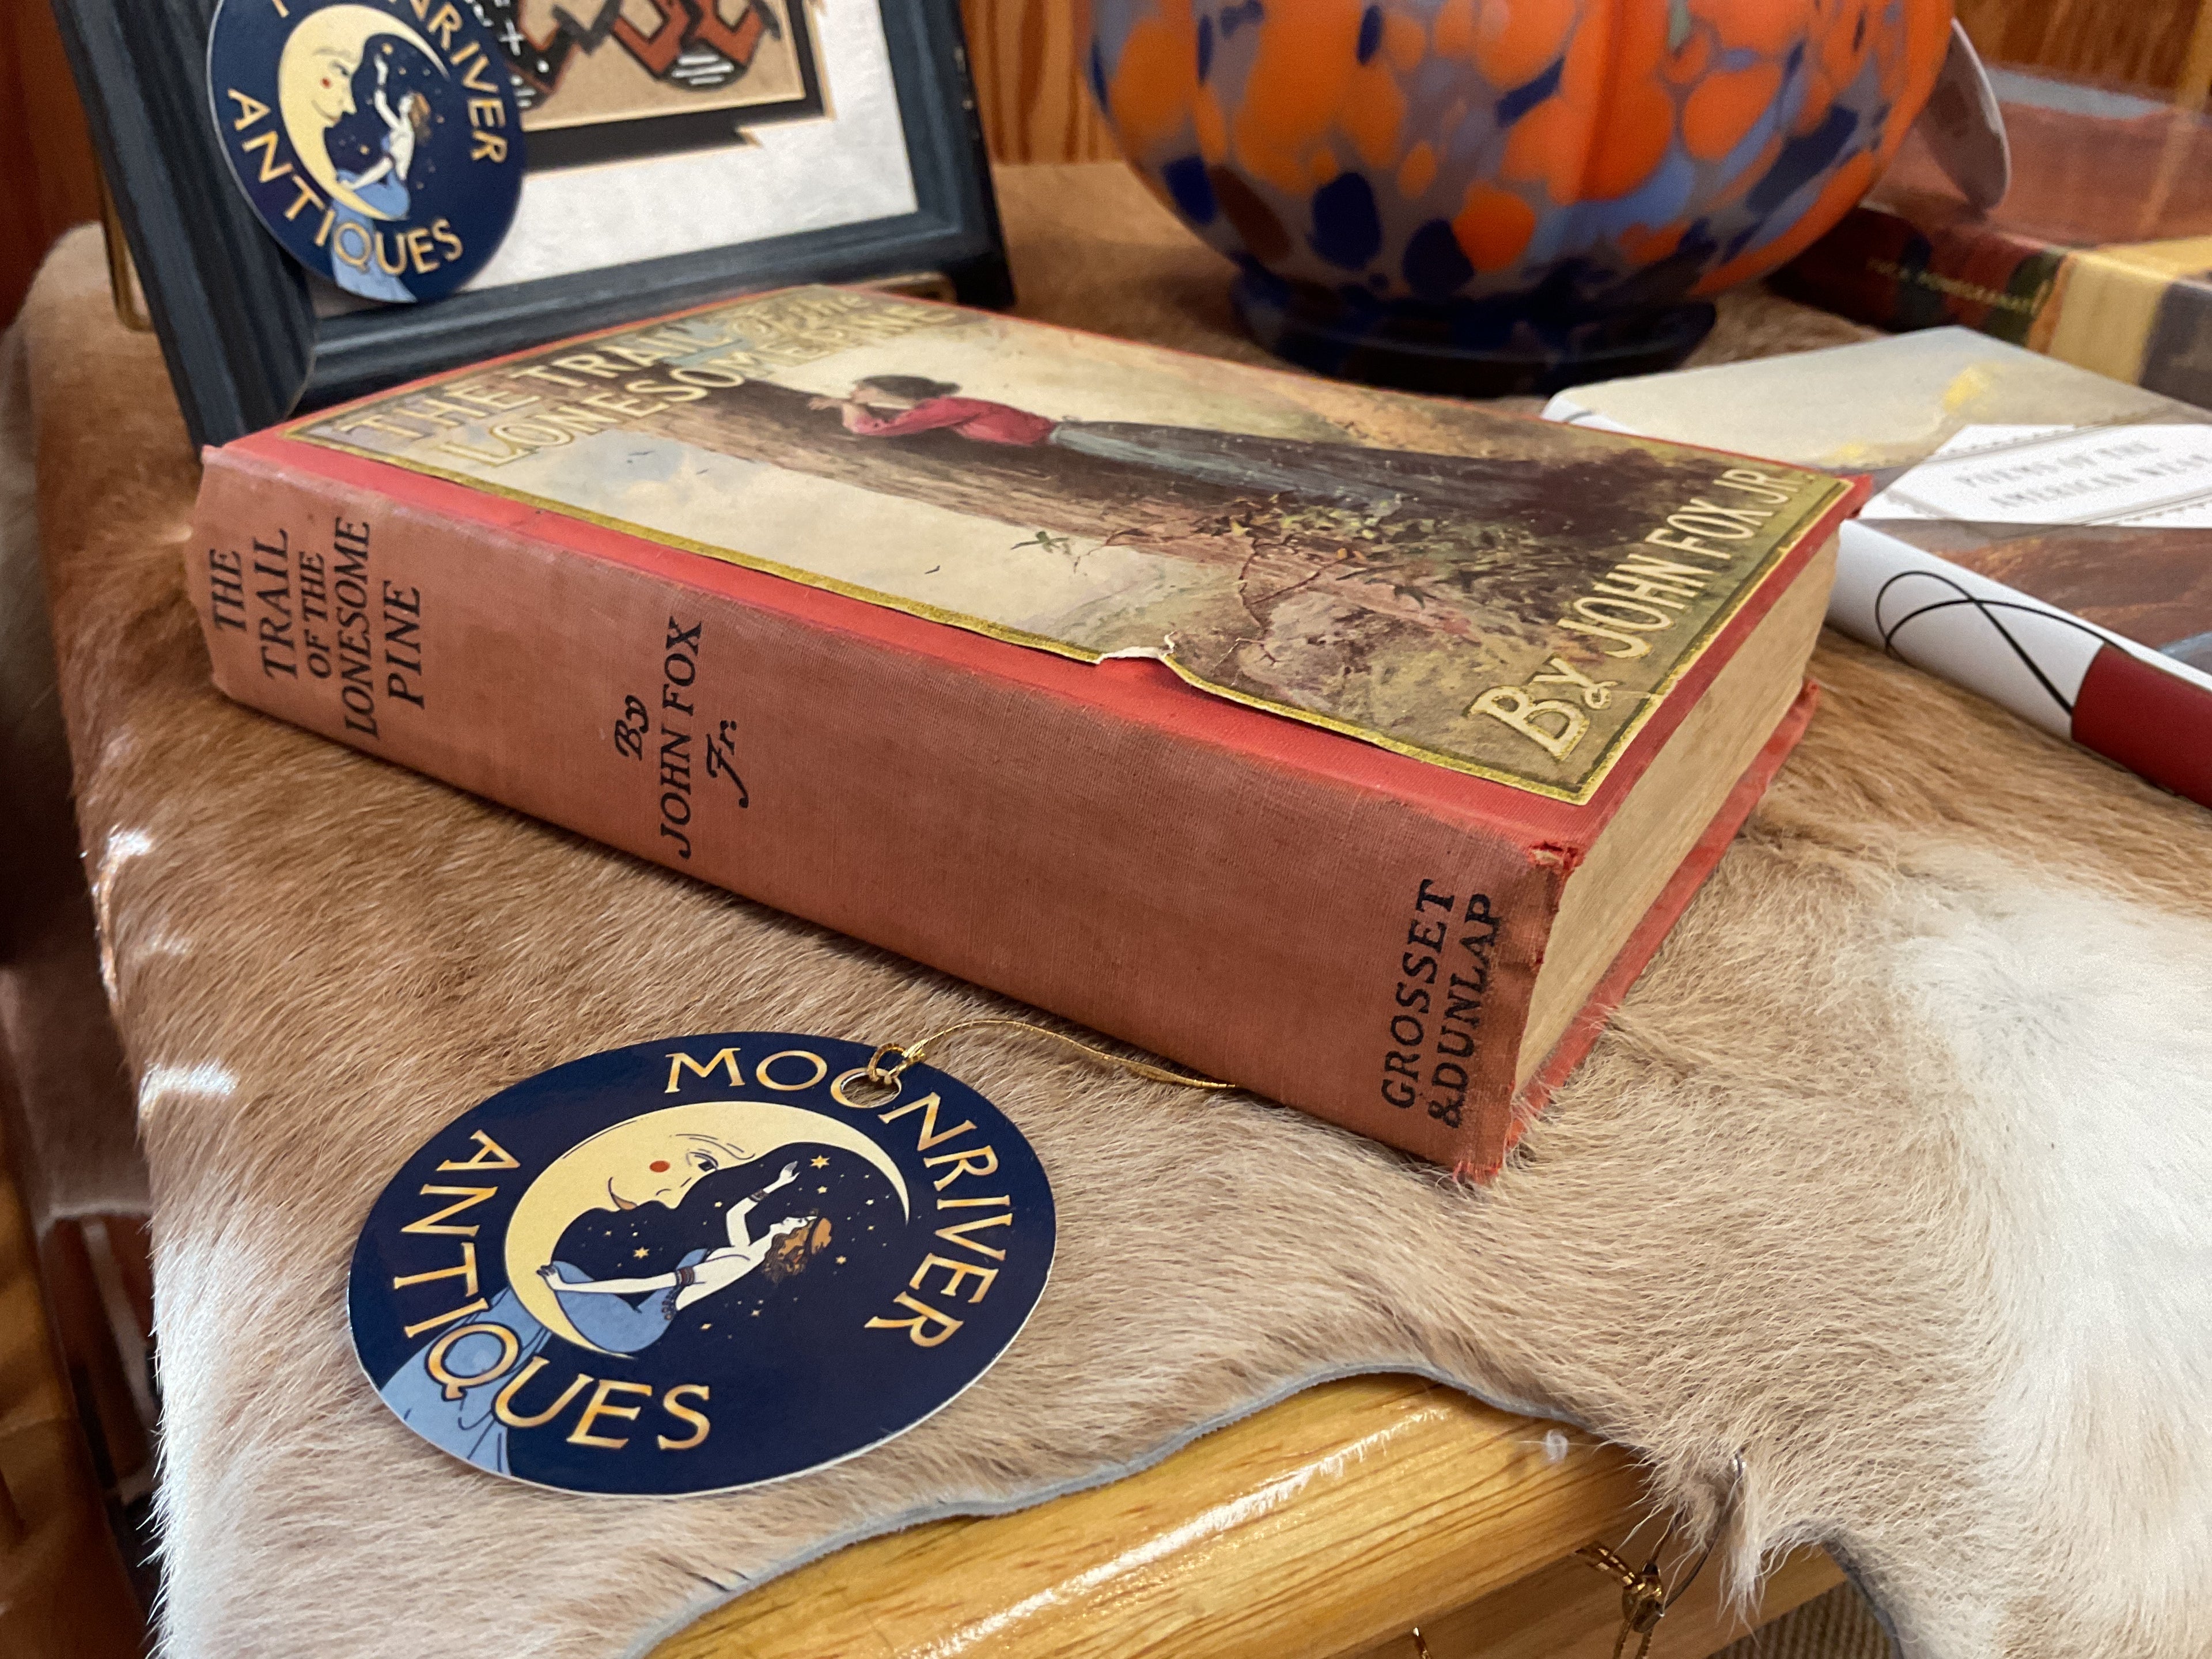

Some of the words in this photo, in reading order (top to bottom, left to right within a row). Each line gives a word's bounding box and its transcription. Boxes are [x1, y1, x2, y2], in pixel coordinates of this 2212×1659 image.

[228, 89, 462, 275] ANTIQUES
[340, 385, 540, 440] THE
[511, 328, 732, 388] TRAIL
[209, 548, 247, 631] THE
[252, 528, 298, 680] TRAIL
[299, 551, 328, 622] THE
[334, 517, 380, 740] LONESOME
[384, 580, 425, 709] PINE
[1557, 553, 1720, 658] JOHN
[1645, 497, 1772, 560] FOX
[306, 628, 332, 679] OF
[662, 615, 702, 717] FOX
[660, 724, 692, 860] JOHN
[1381, 878, 1455, 1109] GROSSET
[664, 1047, 1013, 1348] MOONRIVER
[393, 1129, 710, 1450] ANTIQUES
